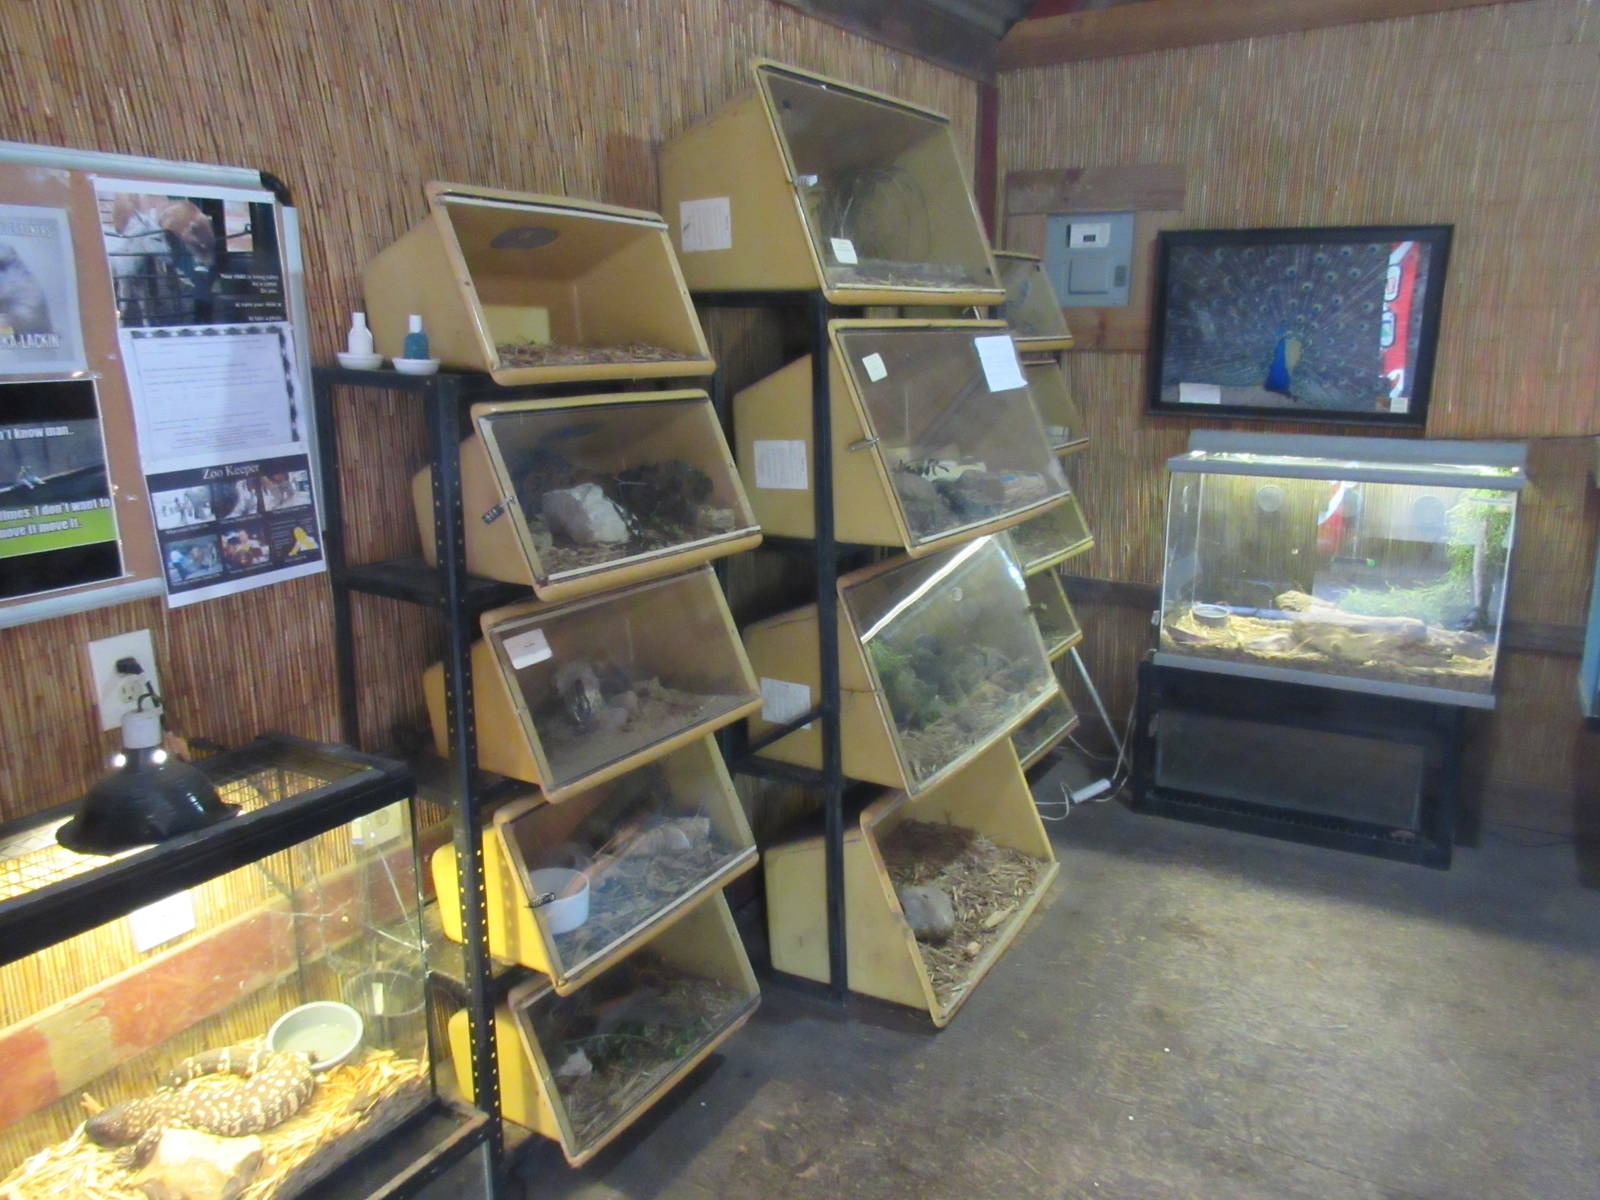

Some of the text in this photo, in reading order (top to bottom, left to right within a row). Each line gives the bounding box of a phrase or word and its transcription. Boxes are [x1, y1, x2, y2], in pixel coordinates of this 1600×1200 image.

[13, 427, 44, 439] know
[202, 464, 259, 480] Zoo Keeper
[41, 502, 70, 516] don't
[71, 499, 98, 513] want
[99, 498, 111, 508] to
[38, 520, 69, 533] move
